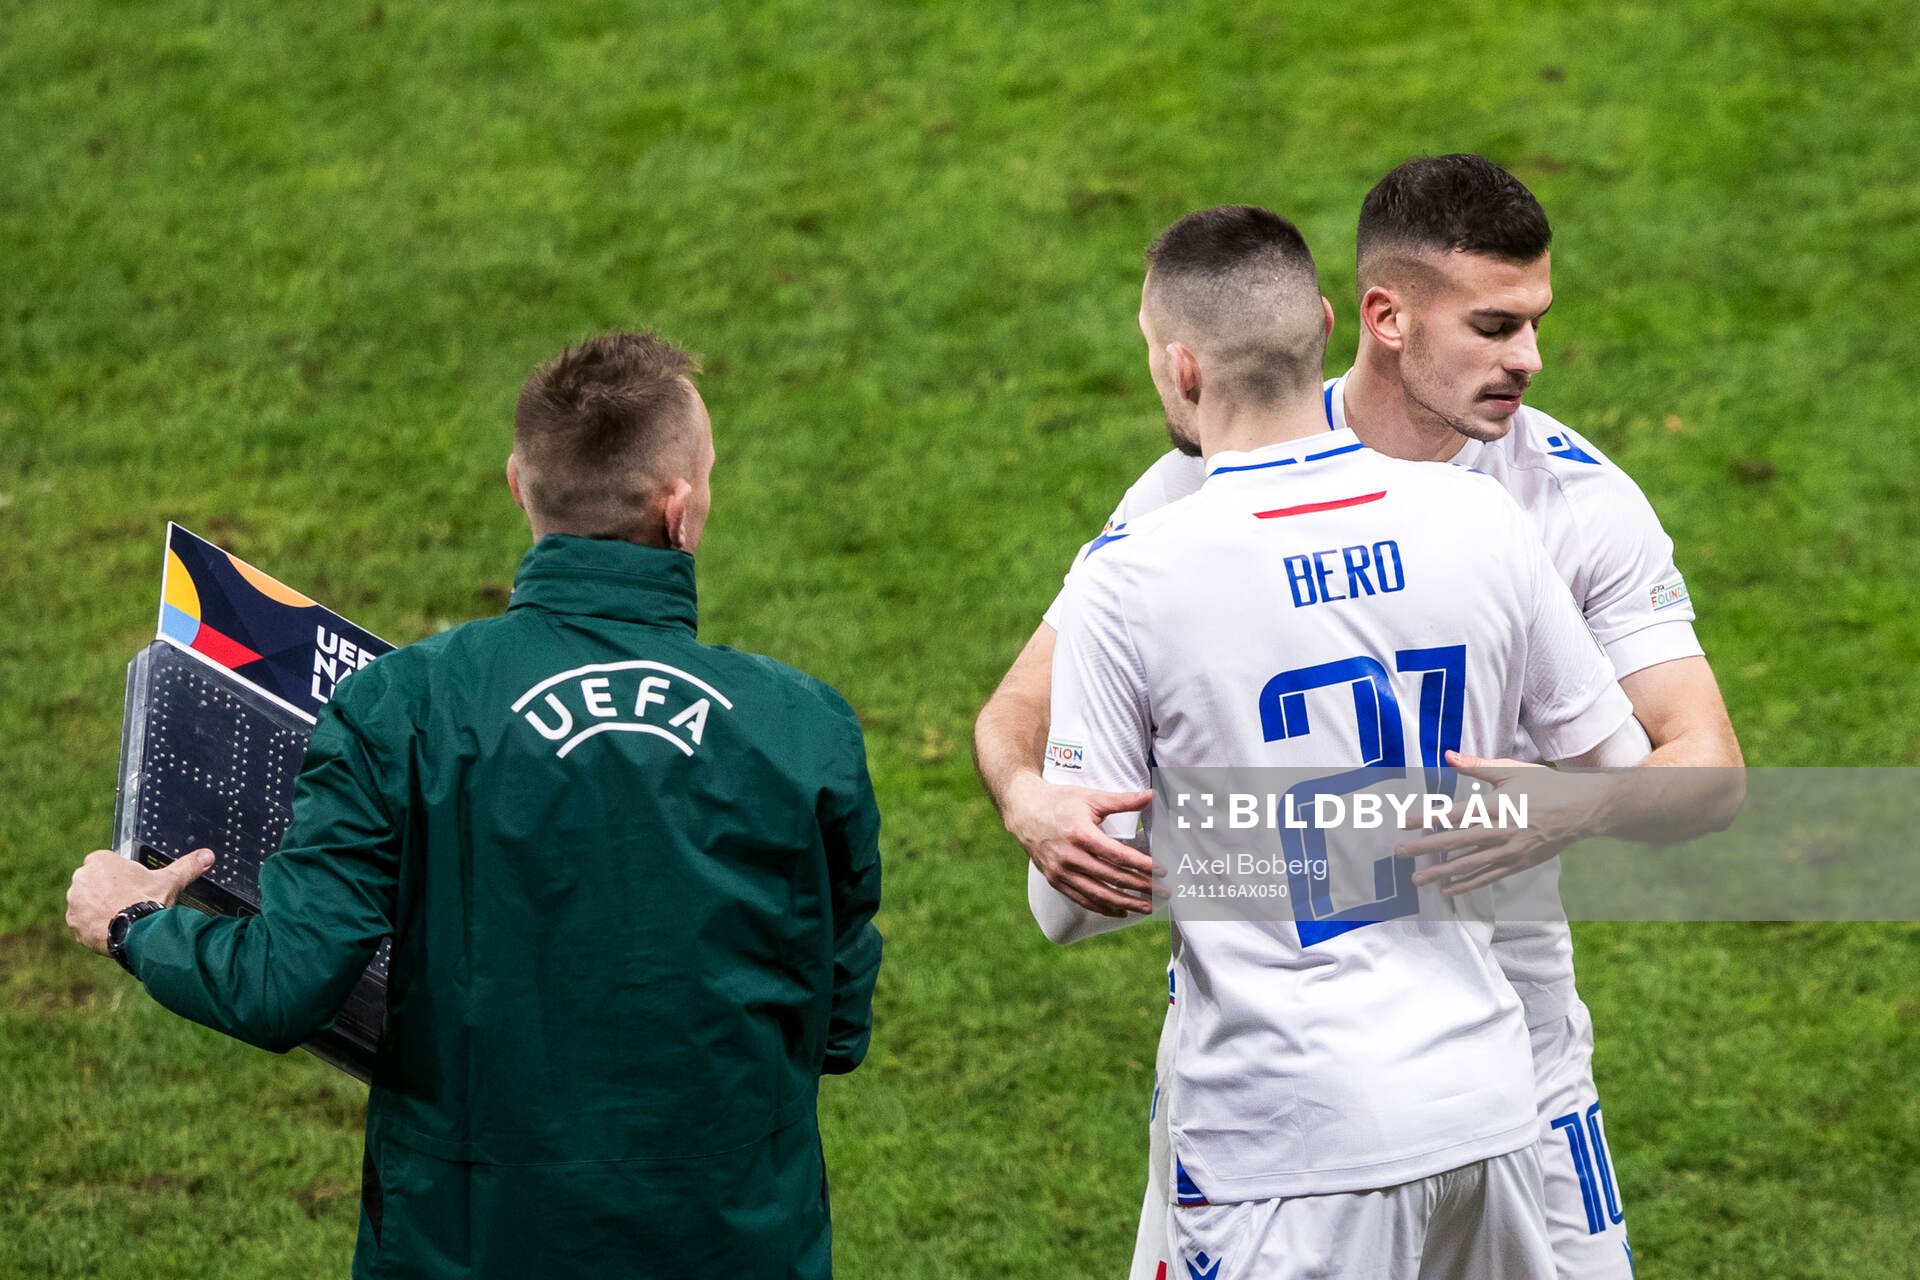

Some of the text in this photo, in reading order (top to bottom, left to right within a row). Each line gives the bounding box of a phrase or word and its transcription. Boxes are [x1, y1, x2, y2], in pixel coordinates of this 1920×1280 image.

[1283, 539, 1406, 608] BERO
[316, 624, 377, 671] UEF
[524, 676, 711, 745] UEFA
[1258, 644, 1467, 949] 21
